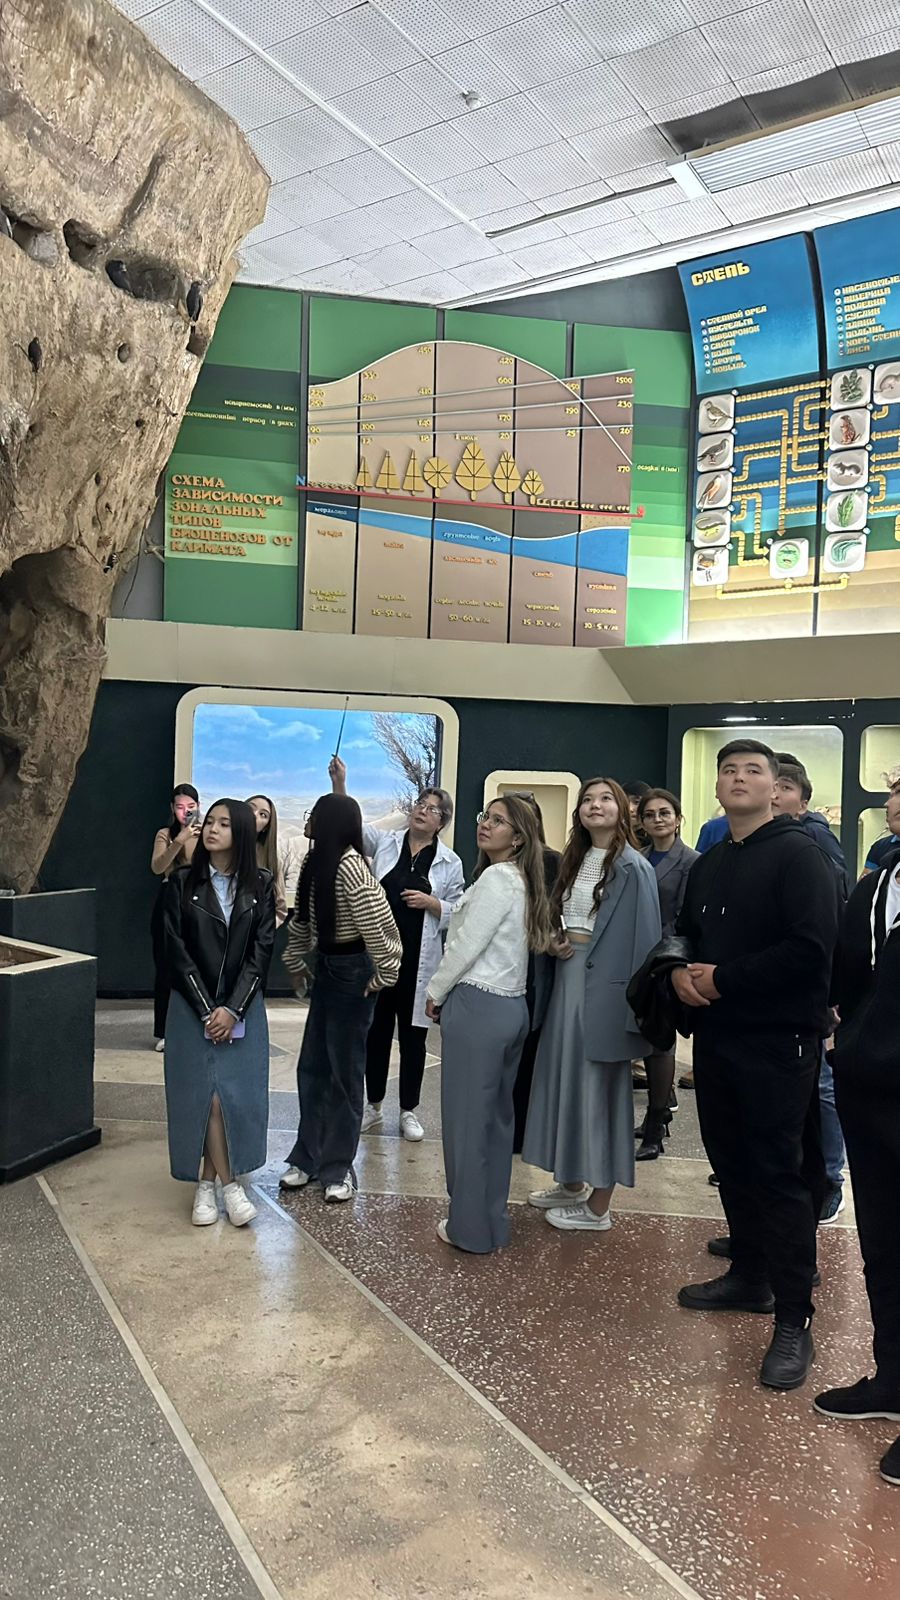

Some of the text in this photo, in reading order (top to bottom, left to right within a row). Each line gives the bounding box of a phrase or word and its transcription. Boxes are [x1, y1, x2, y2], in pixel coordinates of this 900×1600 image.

[691, 263, 750, 286] СТЕПЬ
[171, 474, 225, 488] СХЕМА
[295, 474, 306, 486] N
[171, 487, 284, 506] ЗАВИСИМОСТИ
[171, 501, 266, 518] ЗОНАЛЬНЫХ
[171, 514, 222, 528] ТИПОВ
[170, 527, 293, 546] БИОЦЕНОЗОВ ОТ
[170, 541, 246, 556] КЛИМАТА
